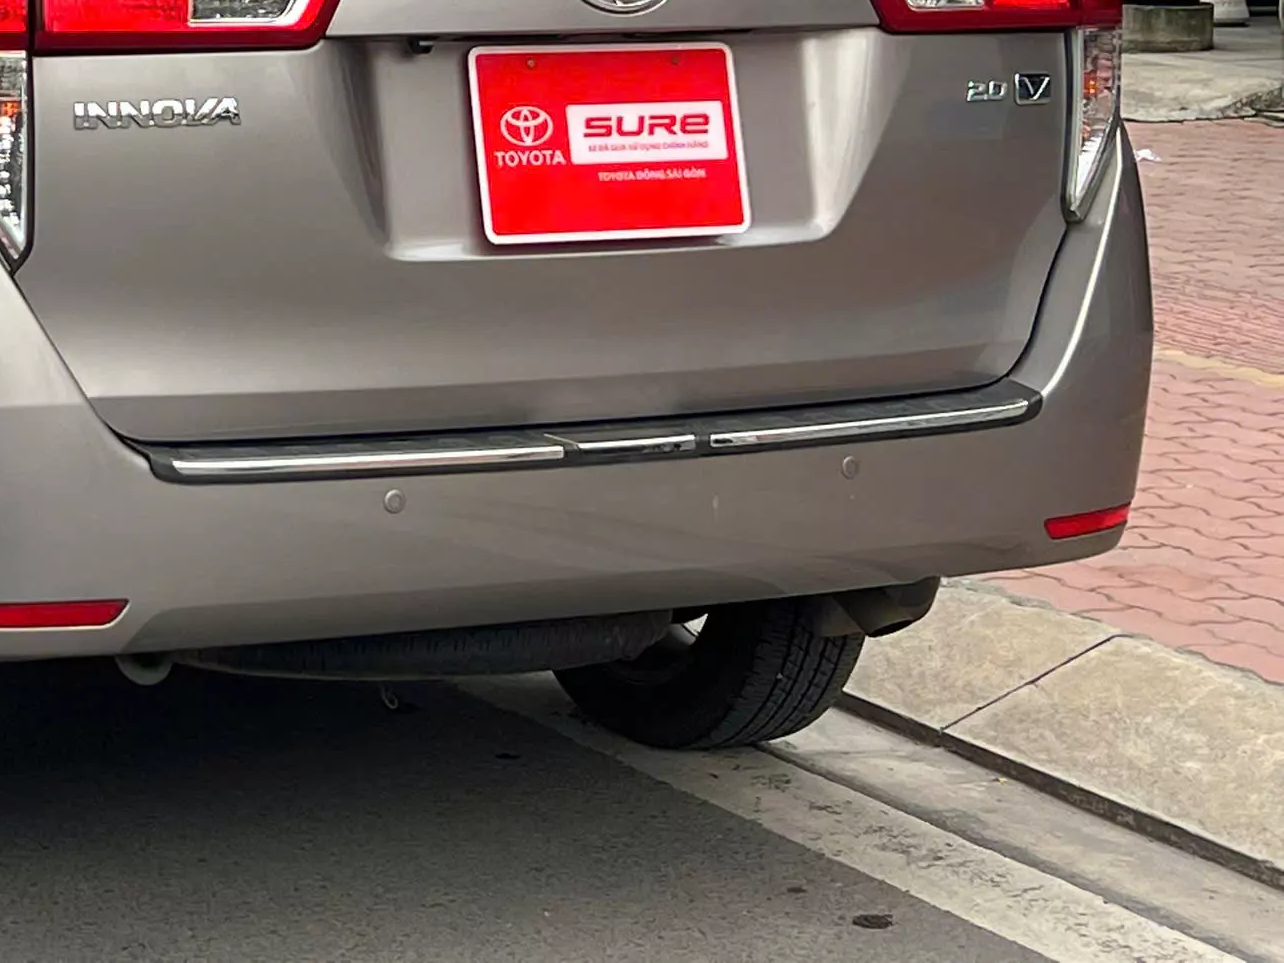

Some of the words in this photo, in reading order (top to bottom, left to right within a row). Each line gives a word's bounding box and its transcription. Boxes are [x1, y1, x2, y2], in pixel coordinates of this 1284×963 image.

[73, 96, 243, 131] INNOVA
[494, 149, 567, 168] TOYOTA
[598, 170, 637, 182] TOYOTA
